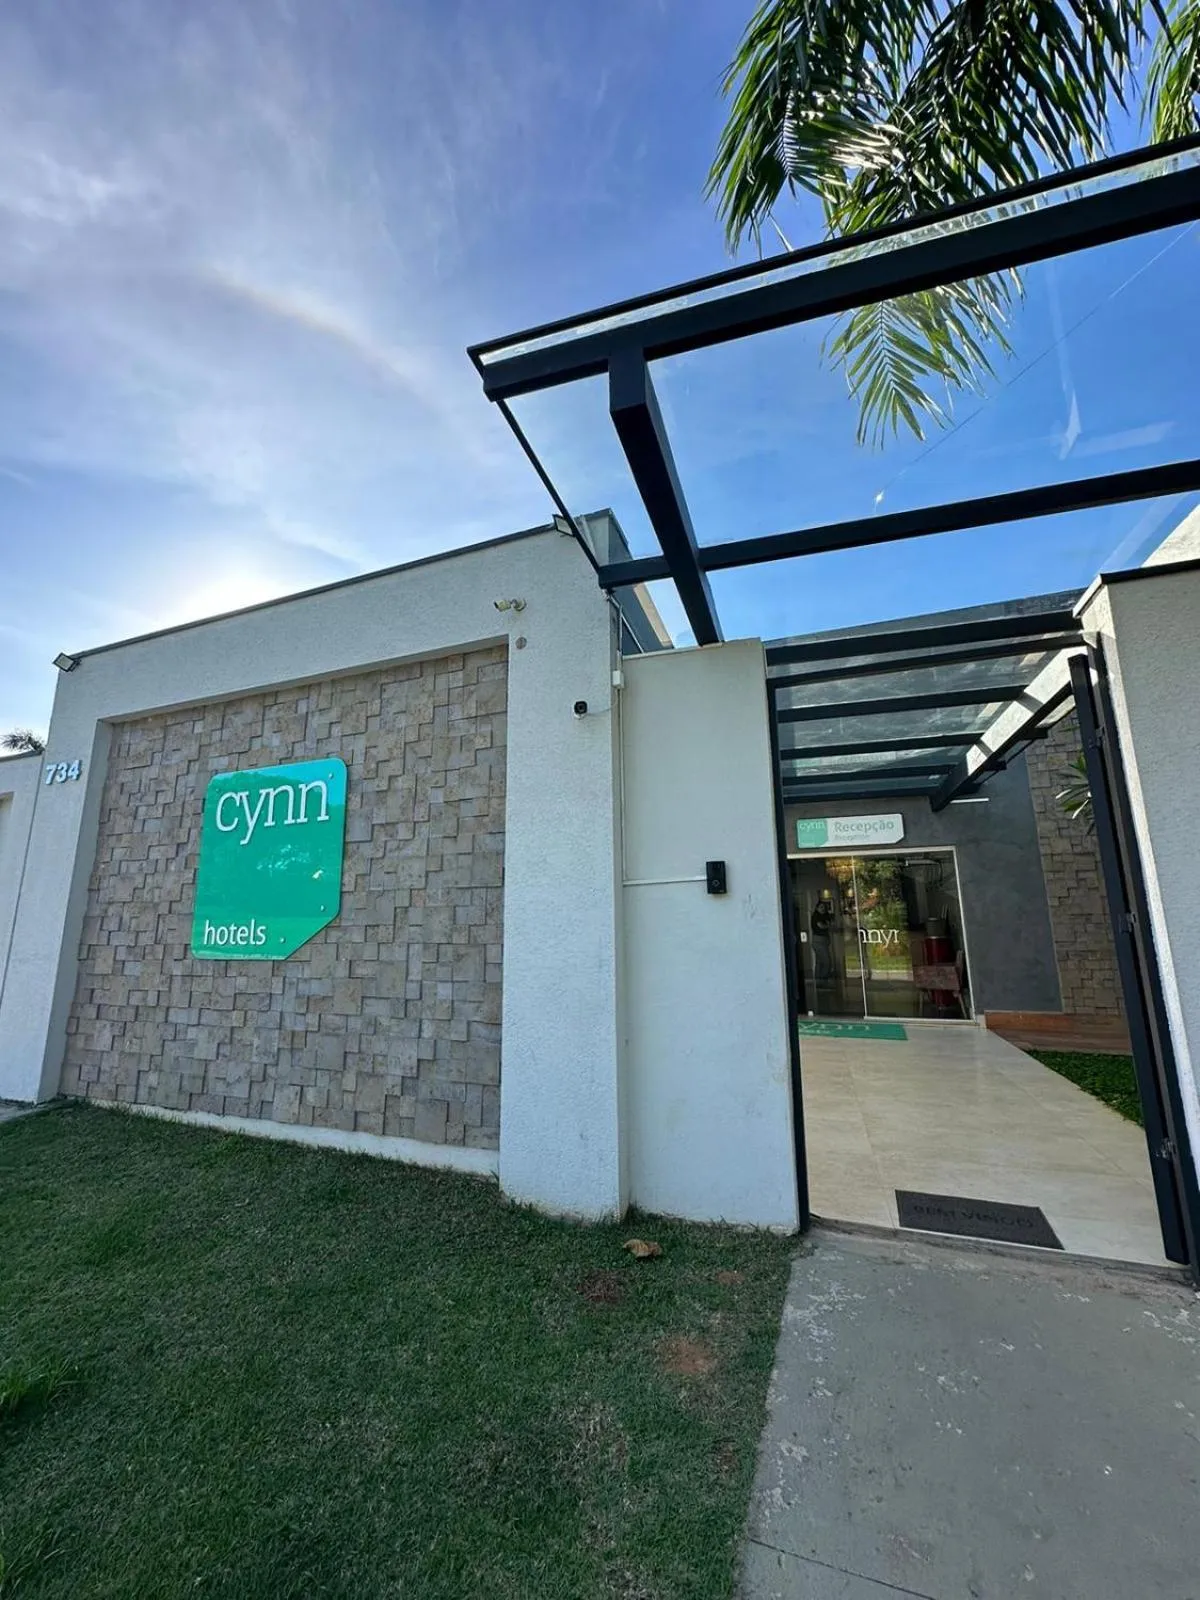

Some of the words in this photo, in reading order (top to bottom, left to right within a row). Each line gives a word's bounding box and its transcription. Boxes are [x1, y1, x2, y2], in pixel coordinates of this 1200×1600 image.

[45, 760, 81, 785] 734
[215, 780, 330, 845] cynn
[833, 819, 895, 834] Recepção
[203, 919, 267, 946] hotels
